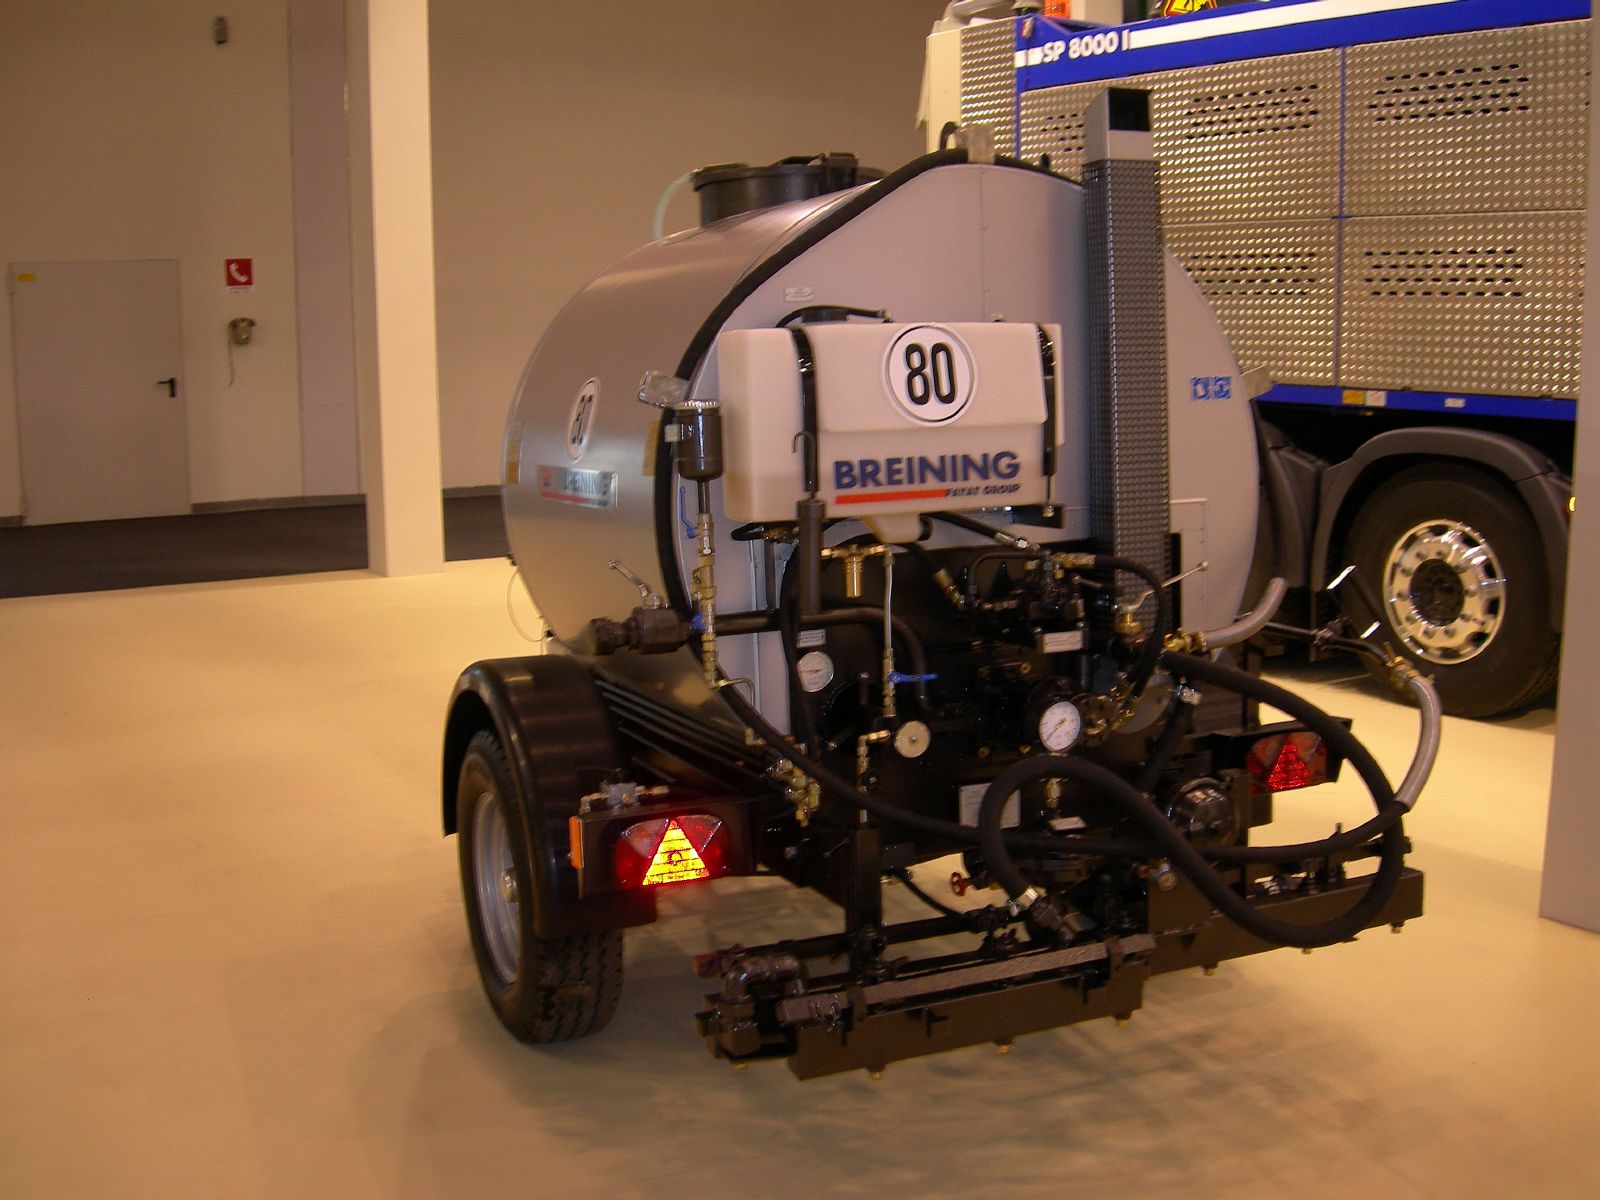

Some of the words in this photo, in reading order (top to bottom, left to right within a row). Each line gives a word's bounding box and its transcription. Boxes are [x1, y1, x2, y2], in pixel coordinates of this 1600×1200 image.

[1041, 40, 1066, 63] SP
[1068, 31, 1119, 59] 8000
[905, 342, 955, 405] 80
[834, 451, 1020, 489] BREINING
